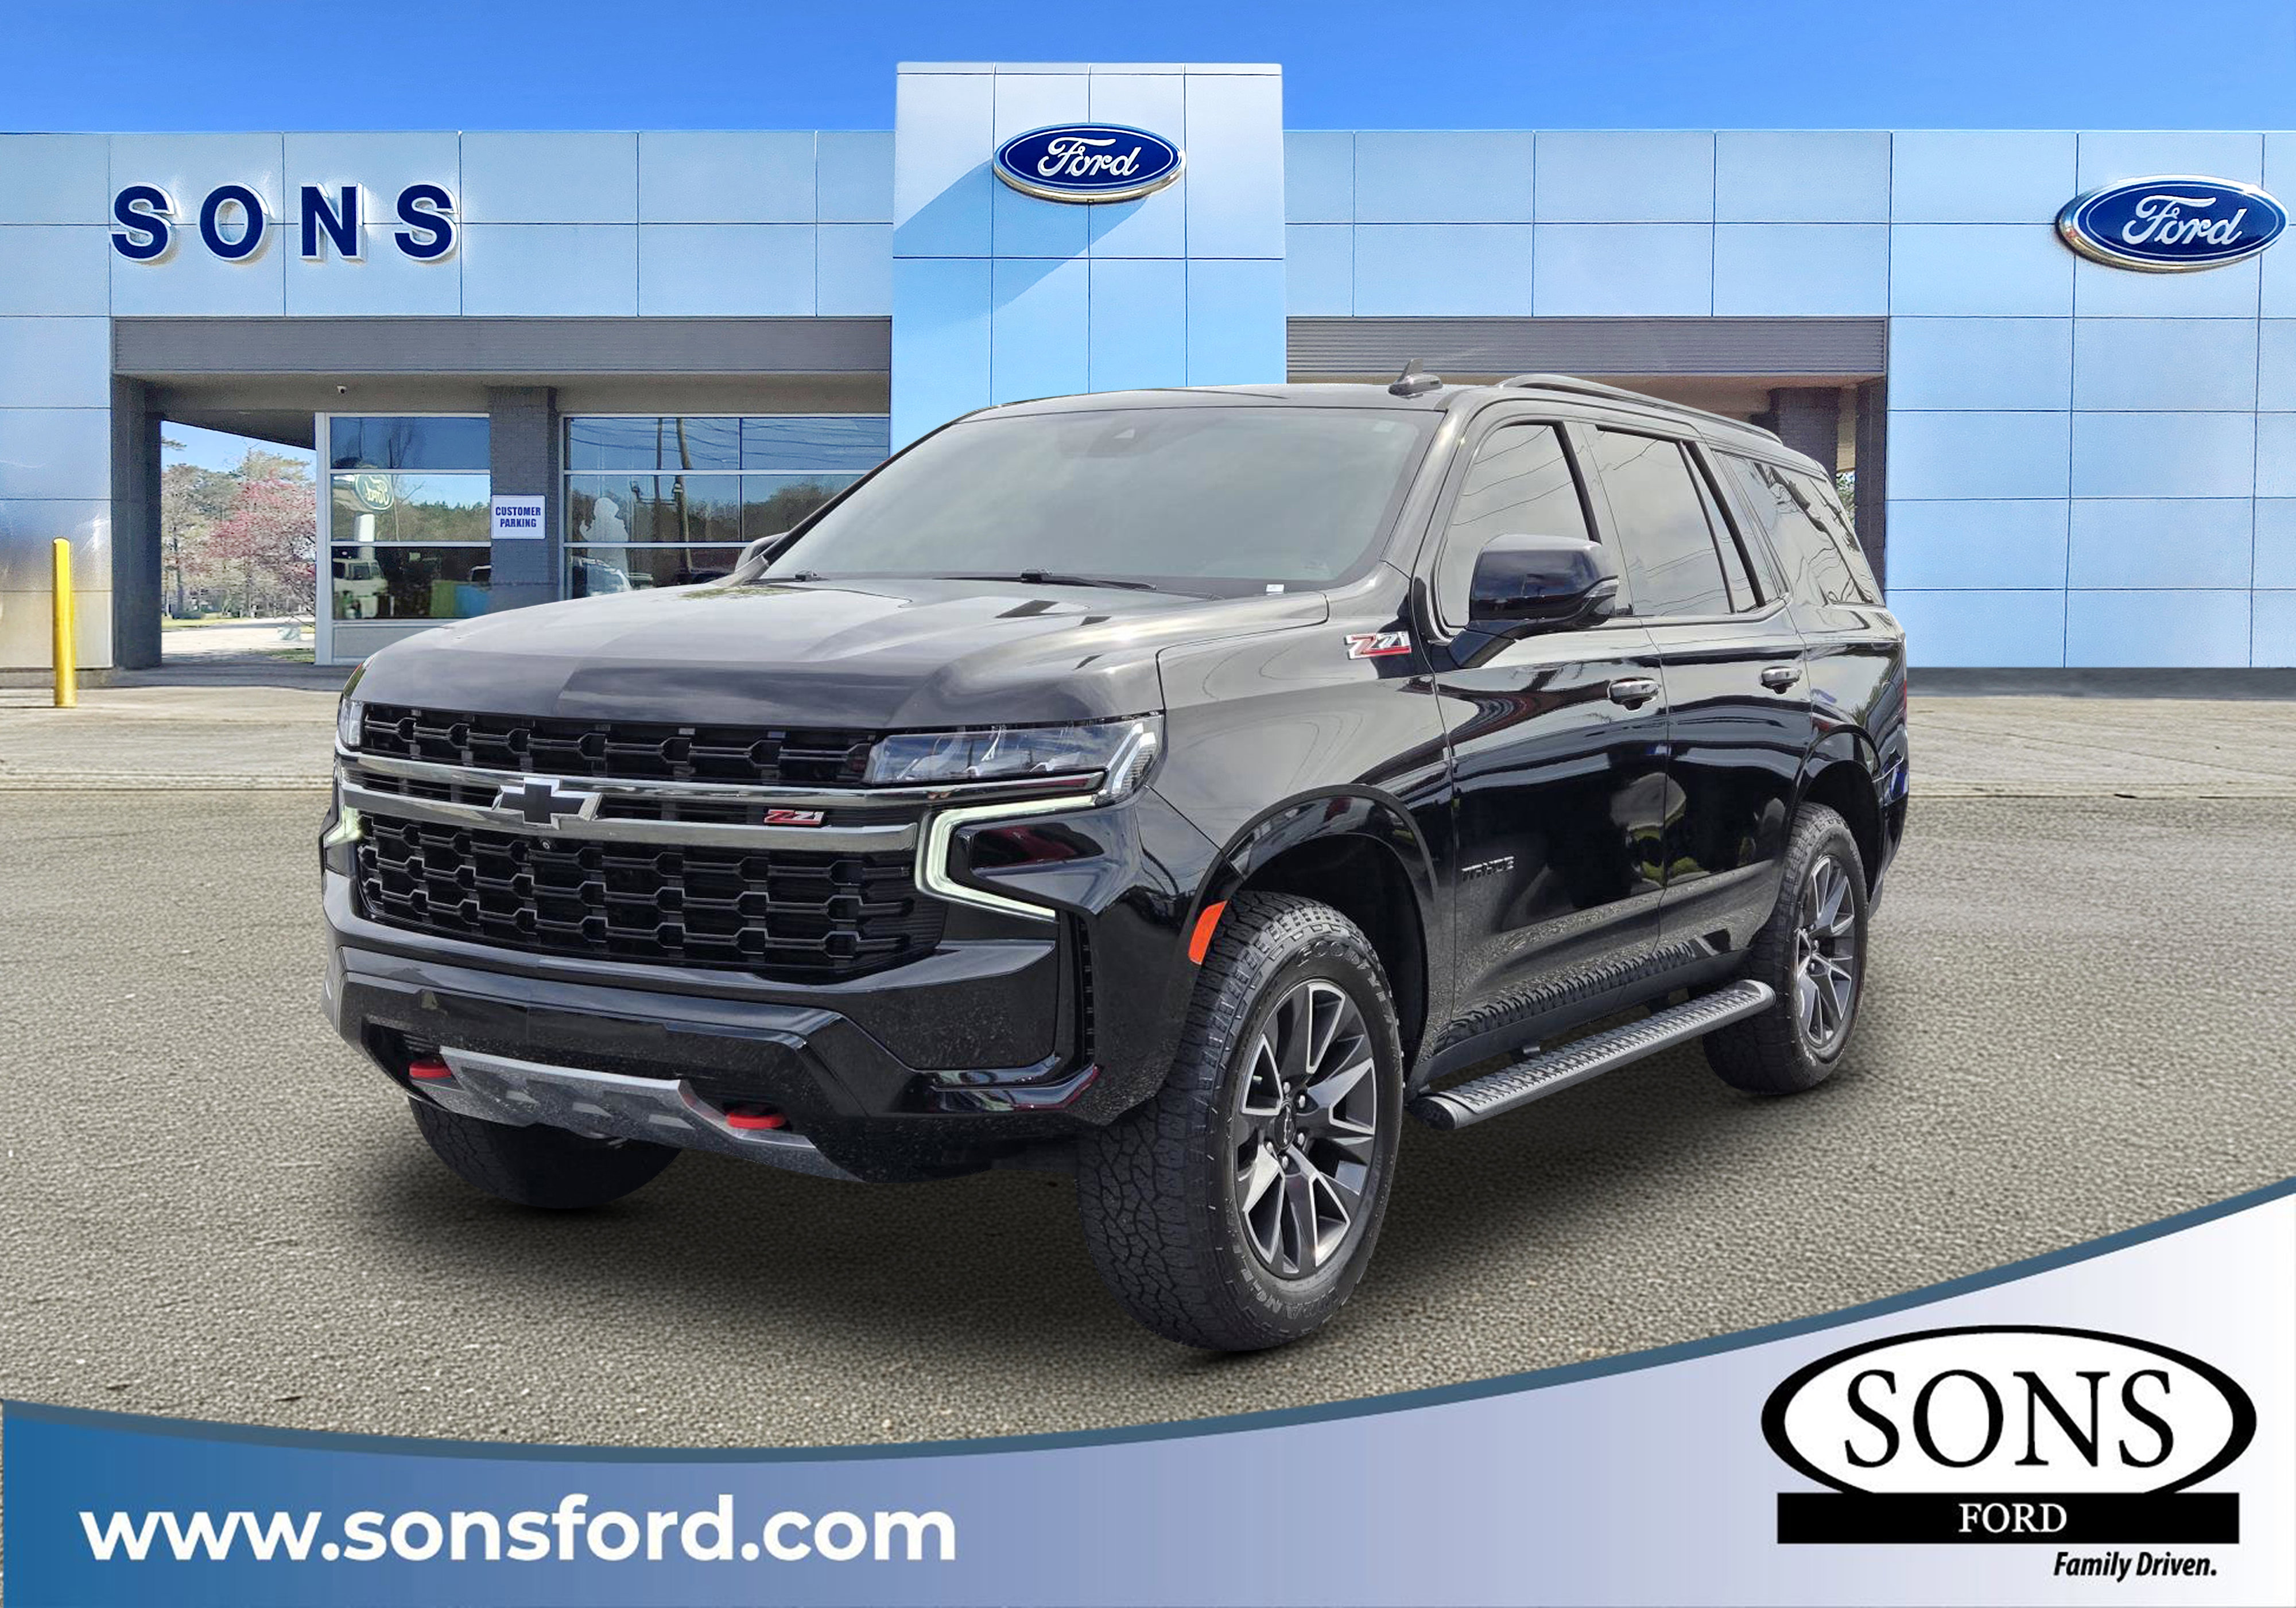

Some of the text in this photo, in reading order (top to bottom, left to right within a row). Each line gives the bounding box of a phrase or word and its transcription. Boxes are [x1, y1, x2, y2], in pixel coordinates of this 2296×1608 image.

[1037, 137, 1139, 176] Ford
[111, 183, 458, 261] SONS
[2122, 195, 2247, 244] Ford
[495, 506, 541, 516] CUSTOMER
[500, 518, 537, 527] PARKING
[1344, 631, 1412, 660] Z71
[763, 809, 825, 825] Z71
